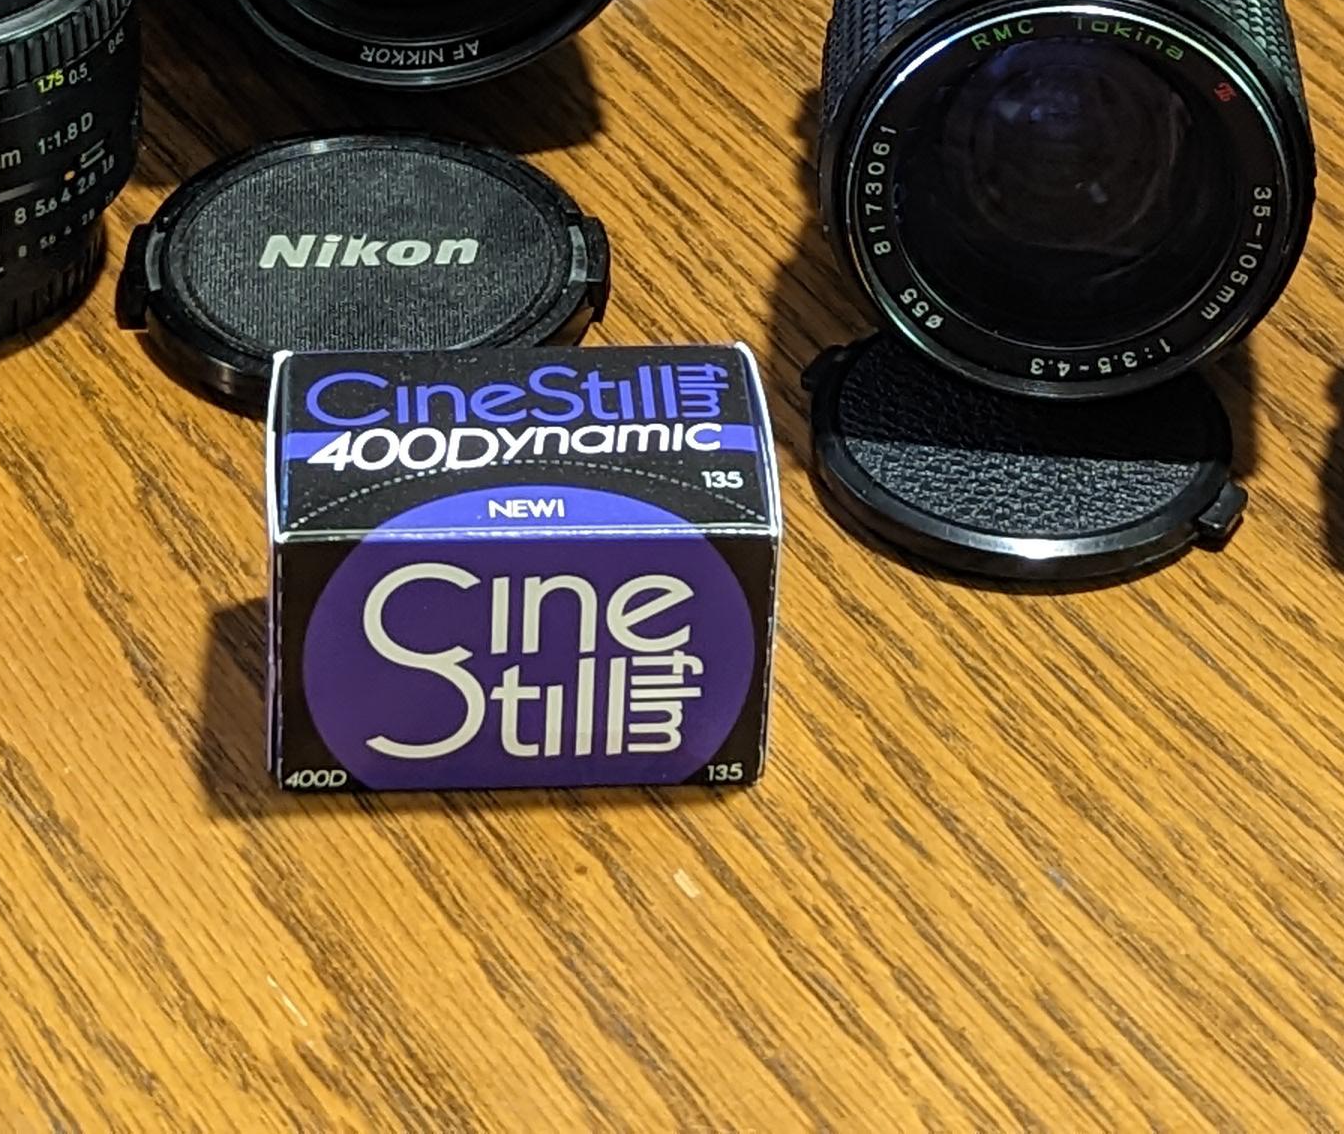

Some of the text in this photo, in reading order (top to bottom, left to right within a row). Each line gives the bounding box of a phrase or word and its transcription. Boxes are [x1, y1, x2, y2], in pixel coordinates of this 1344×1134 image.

[360, 39, 479, 66] AF NIKKOR
[971, 17, 1184, 61] RMC Tokina
[37, 69, 65, 93] 1.75
[69, 63, 88, 85] 0.5
[38, 122, 78, 155] 1:1.8
[81, 112, 93, 132] D
[14, 207, 27, 225] 8
[35, 197, 58, 217] 5.6
[61, 187, 72, 202] 4
[77, 172, 96, 194] 2.8
[865, 125, 898, 255] 8173061
[258, 233, 479, 269] Nikon
[1201, 186, 1272, 320] 35-105mm
[305, 362, 729, 427] CineStill film
[306, 422, 722, 471] 400Dynamic
[701, 470, 744, 489] 135
[363, 562, 695, 660] Cine
[366, 650, 703, 759] Still film
[284, 763, 743, 790] 400D 135
